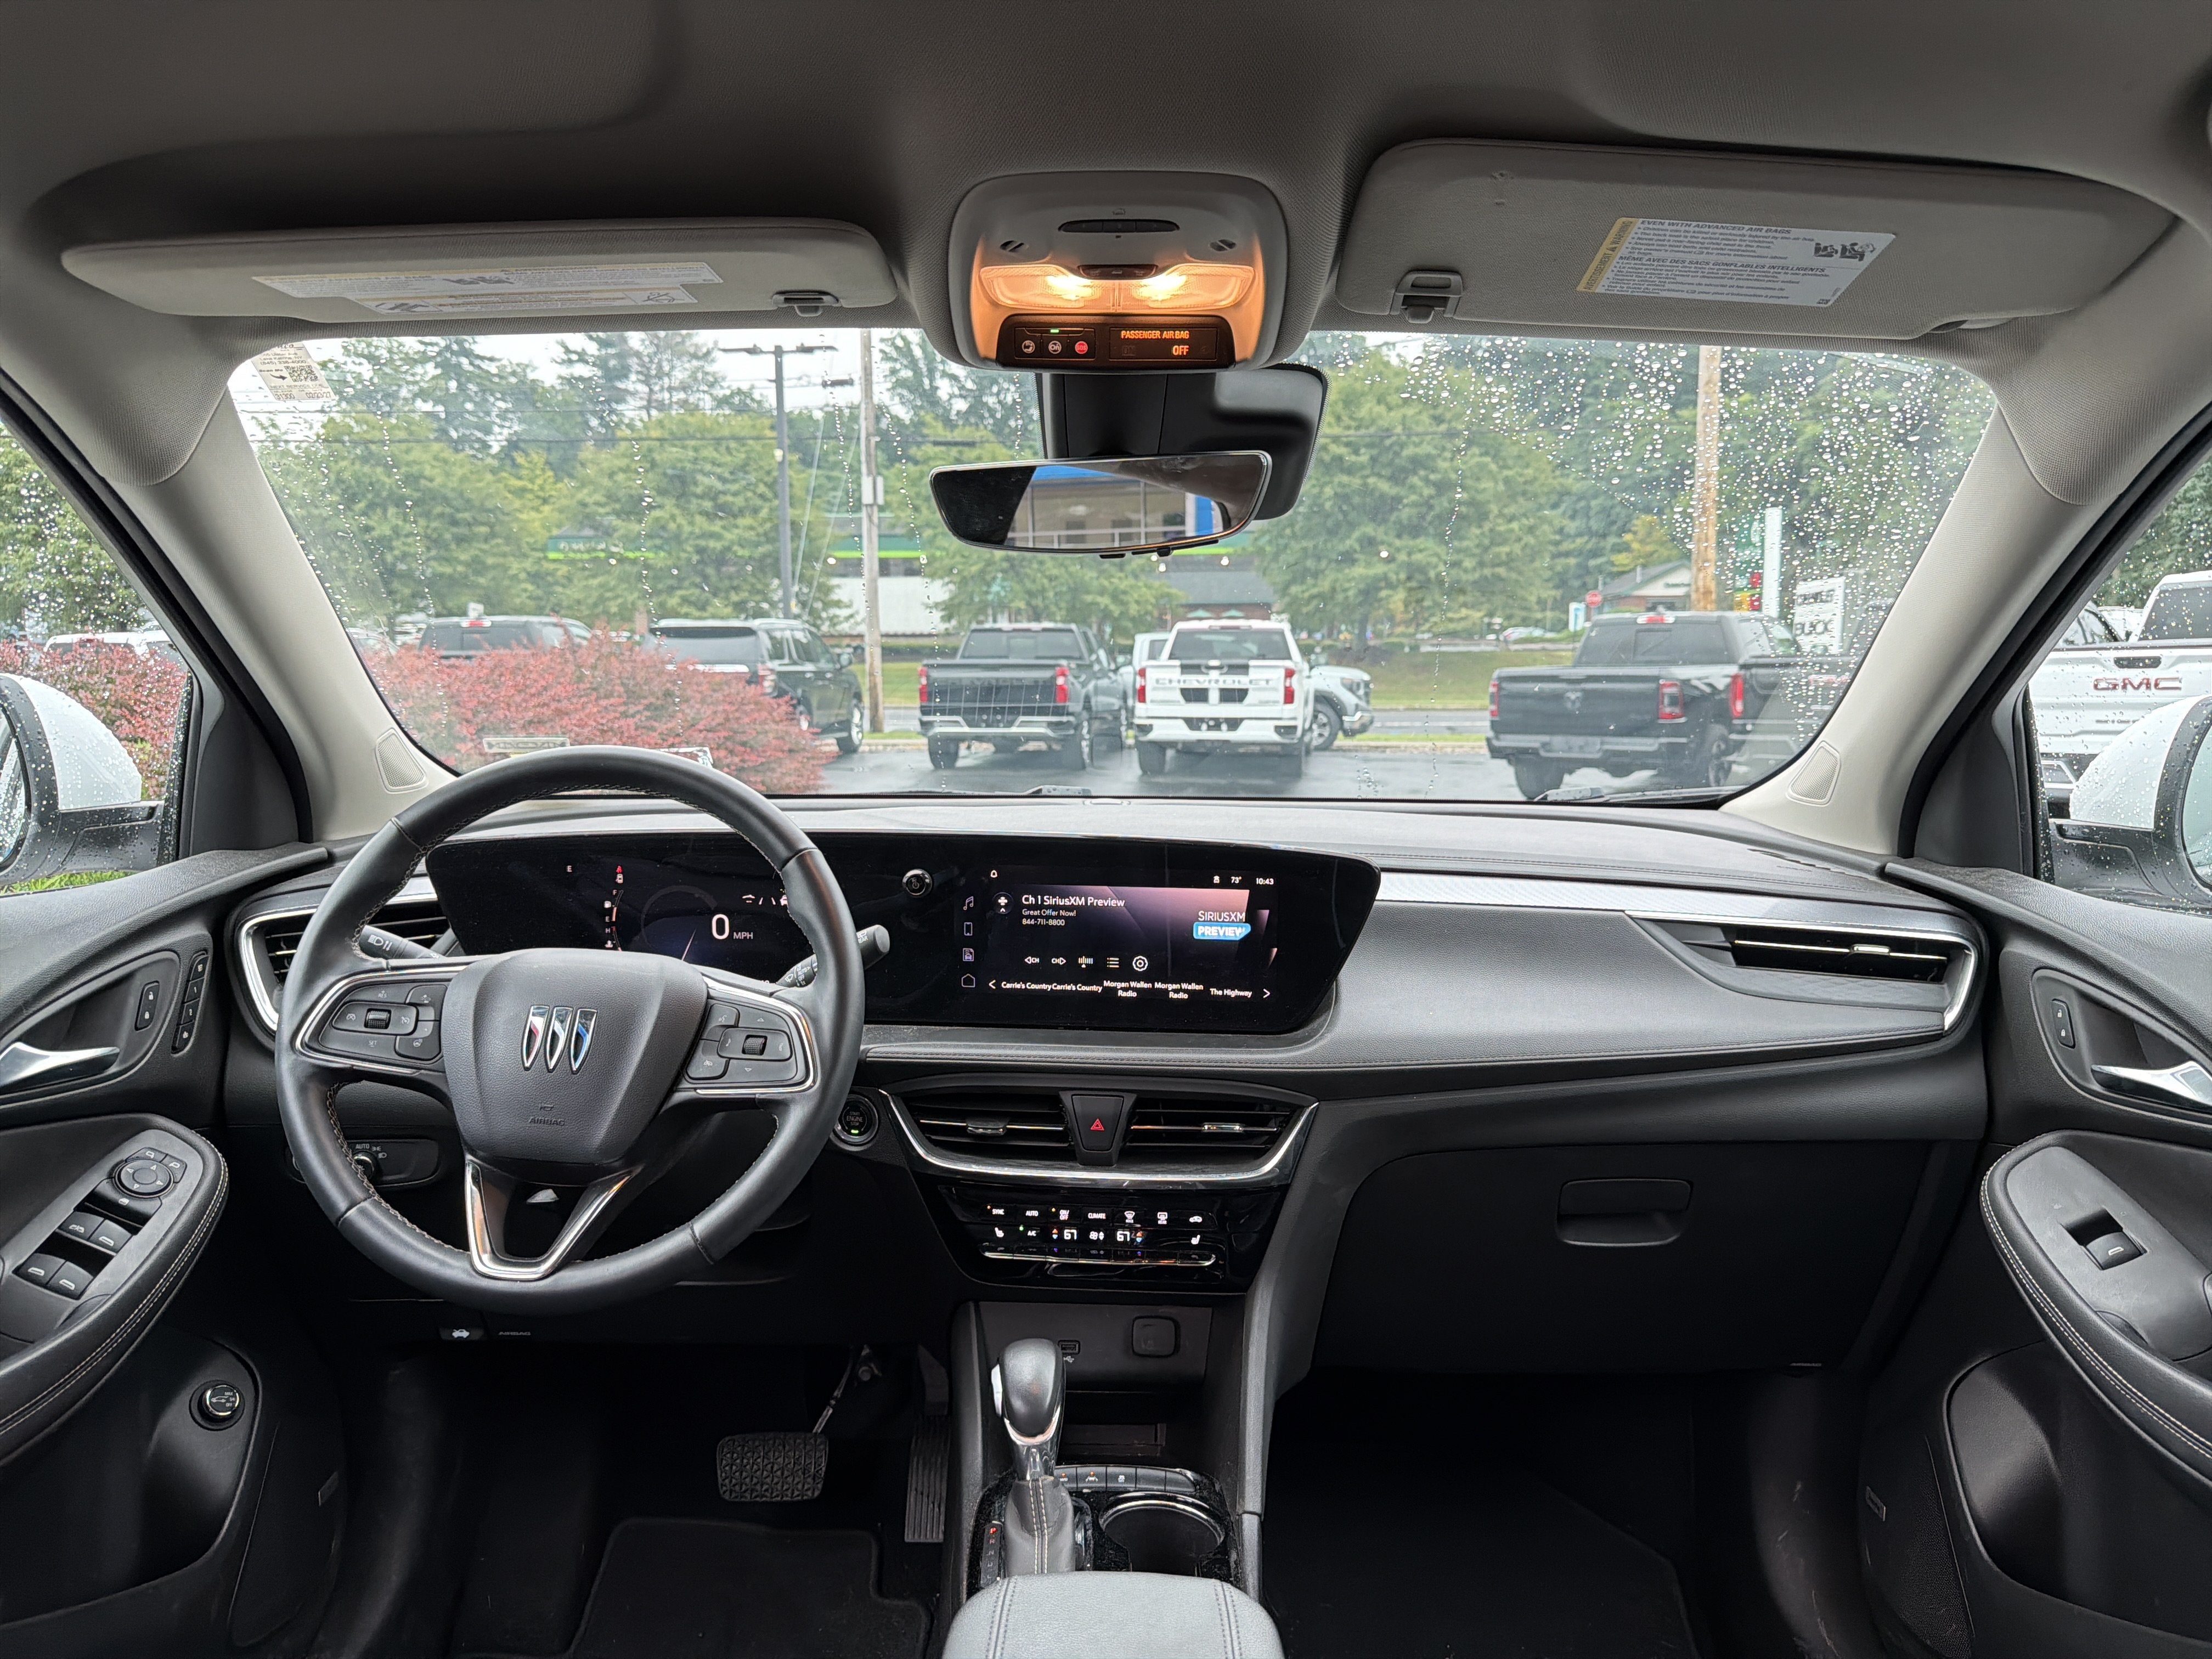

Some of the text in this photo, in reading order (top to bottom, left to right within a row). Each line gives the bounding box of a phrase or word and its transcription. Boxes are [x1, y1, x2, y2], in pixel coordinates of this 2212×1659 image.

[1692, 223, 1745, 231] ADVANCED
[1610, 221, 1633, 245] WARNING
[1712, 261, 1766, 269] GONFLABLES
[1583, 253, 1612, 290] AVERTISSEMENT
[1121, 330, 1161, 339] PASSENGER
[1162, 331, 1175, 339] AIR
[1172, 345, 1189, 356] OFF
[2094, 677, 2182, 691] GMC
[1022, 895, 1035, 905] Ch
[1043, 896, 1085, 906] SiriusXM
[1087, 897, 1125, 907] Preview
[1198, 911, 1245, 922] SIRIUSXM
[712, 914, 730, 940] 0
[1198, 926, 1245, 936] PREVIEW
[1026, 983, 1052, 991] Country
[1077, 984, 1103, 992] Country
[1103, 980, 1129, 989] Morgan
[1154, 981, 1180, 990] Morgan
[1169, 991, 1188, 1000] Radio
[1224, 989, 1252, 998] Highway
[528, 1116, 565, 1126] AIRBAG
[1064, 1229, 1077, 1240] 67
[1116, 1231, 1130, 1242] 67
